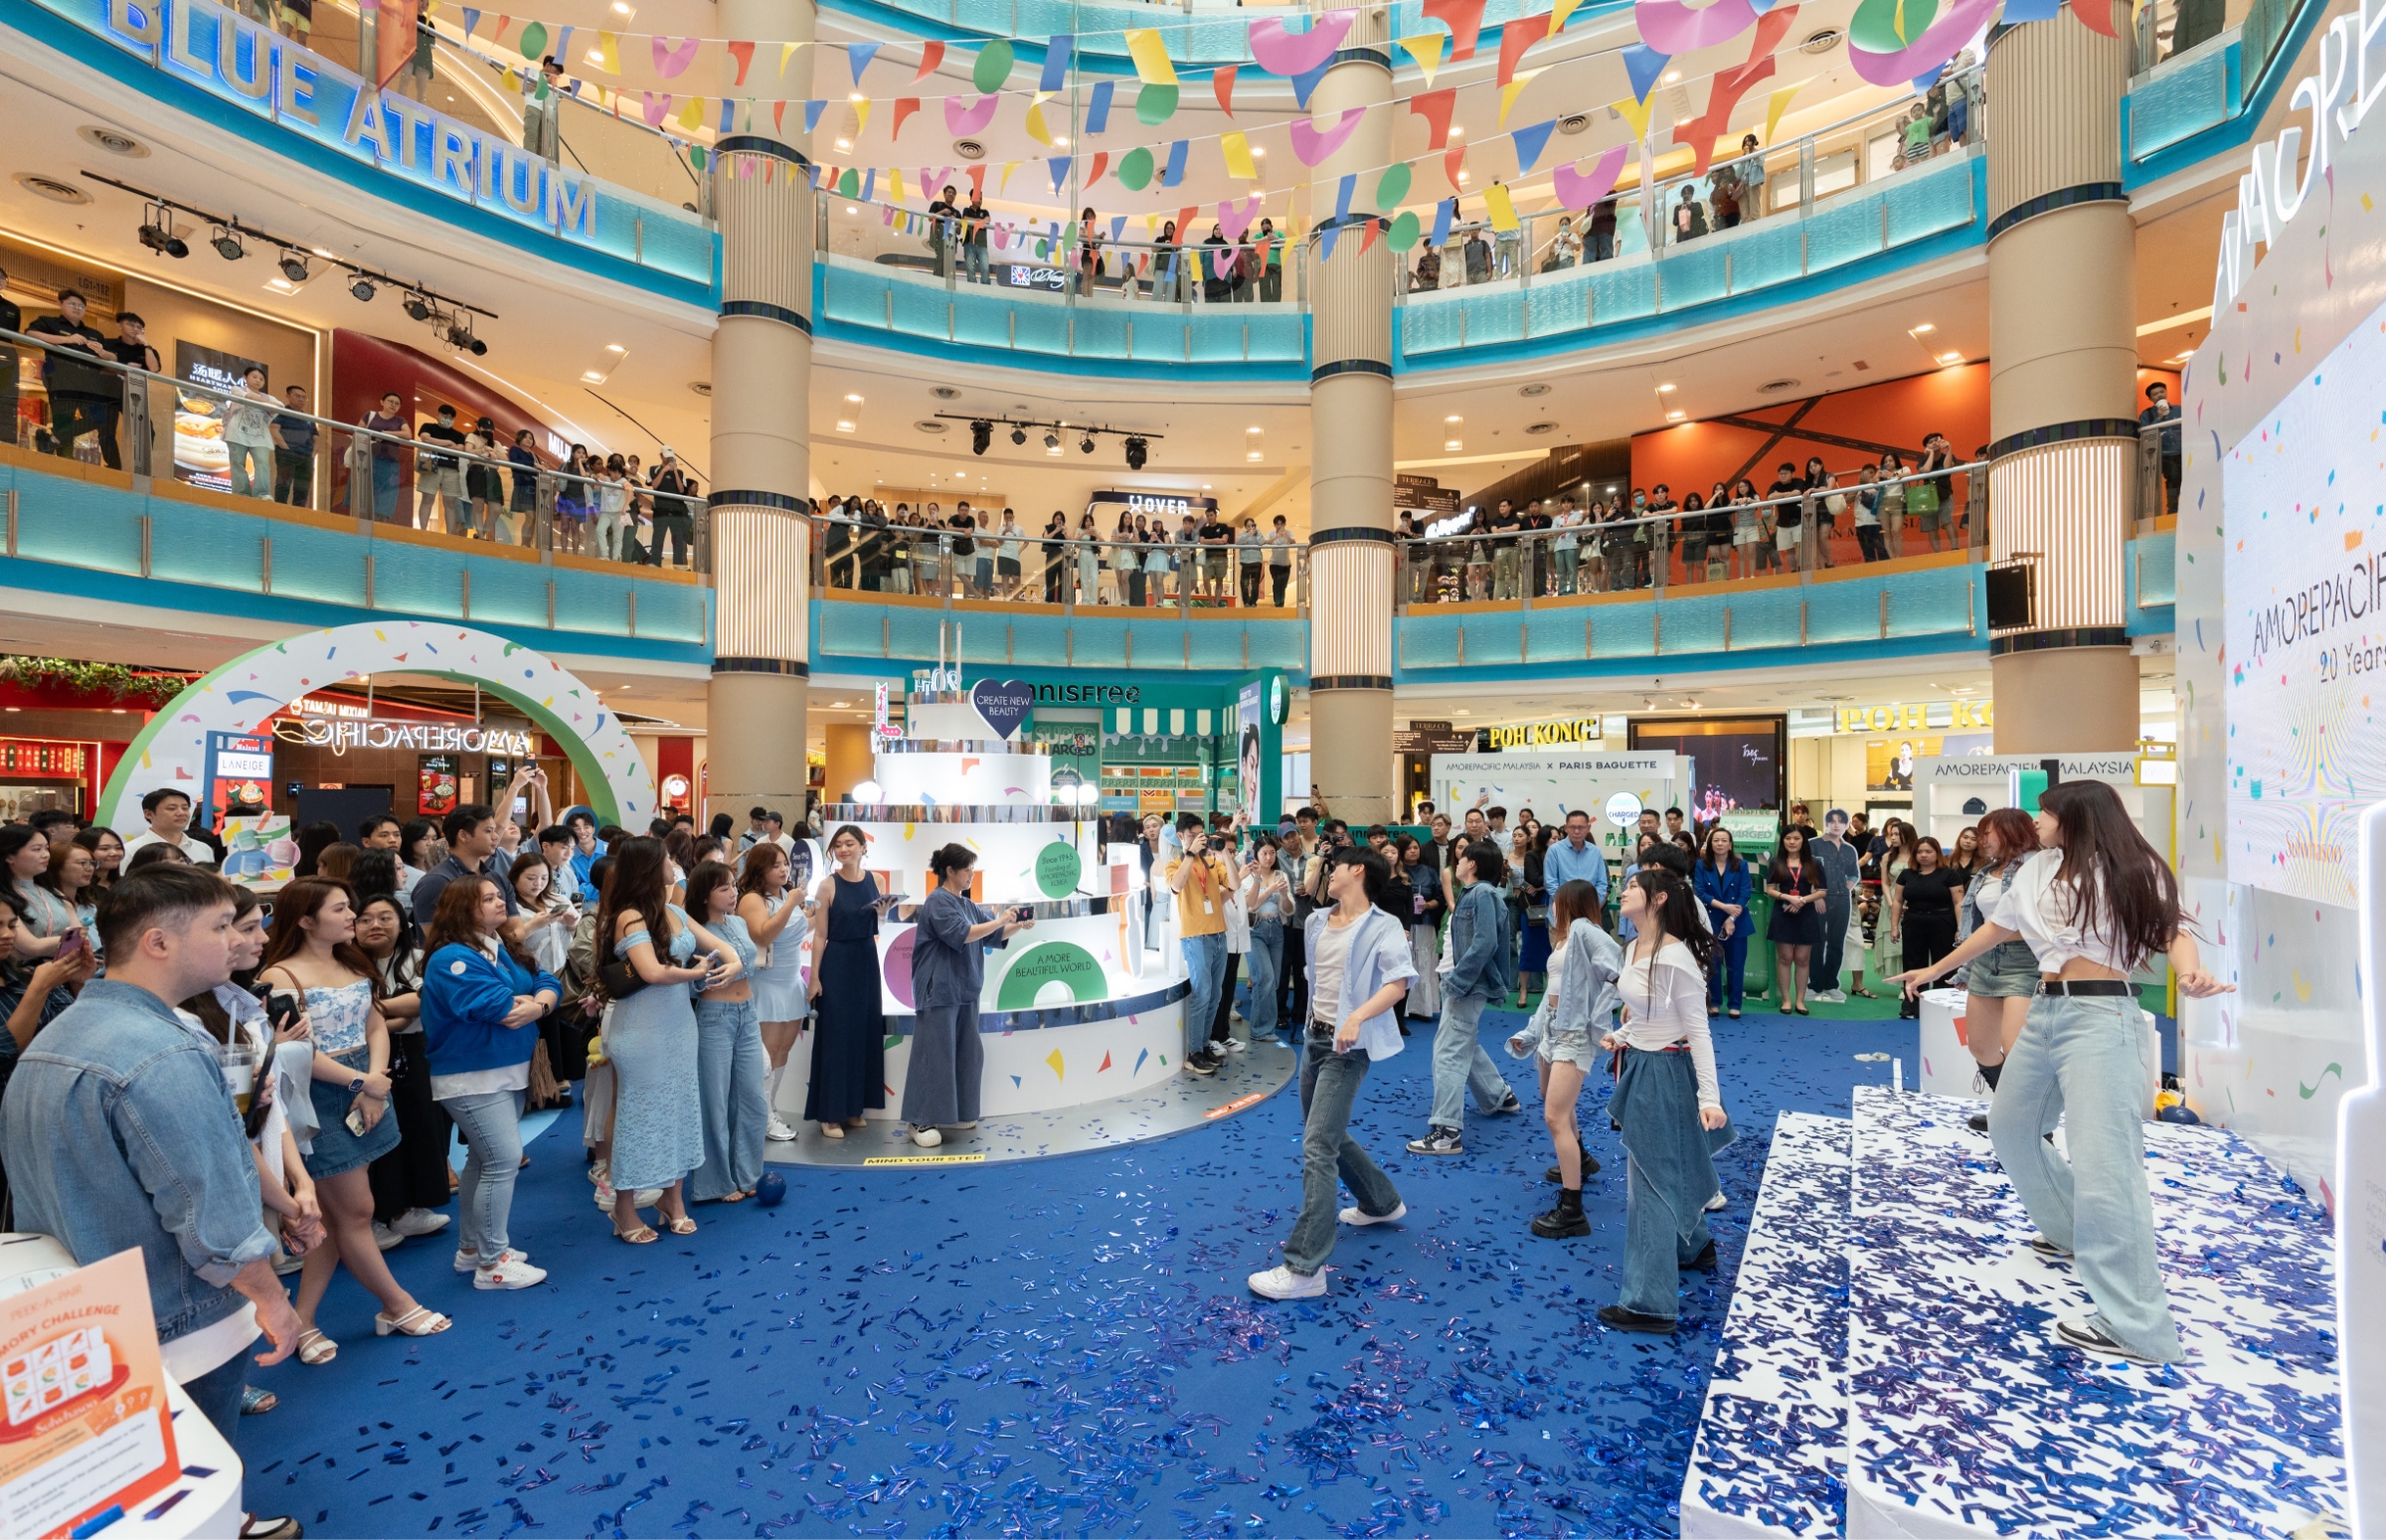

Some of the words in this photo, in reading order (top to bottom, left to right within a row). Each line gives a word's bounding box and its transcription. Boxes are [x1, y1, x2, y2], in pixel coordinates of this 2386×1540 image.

[342, 86, 596, 239] ATRIUM
[2319, 649, 2338, 683] 20
[977, 695, 1007, 705] CREATE
[1010, 697, 1030, 706] NEW
[339, 704, 368, 718] MIXIAN
[989, 707, 1018, 716] BEAUTY
[1838, 704, 1930, 733] POH
[1489, 727, 1527, 749] POH
[223, 760, 263, 770] LANEIGE
[1596, 761, 1657, 770] BAGUETTE
[1016, 965, 1058, 977] BEAUTIFUL
[1060, 961, 1092, 973] WORLD
[42, 1304, 120, 1330] CHALLENGE
[35, 1399, 98, 1434] Sulwhasoo
